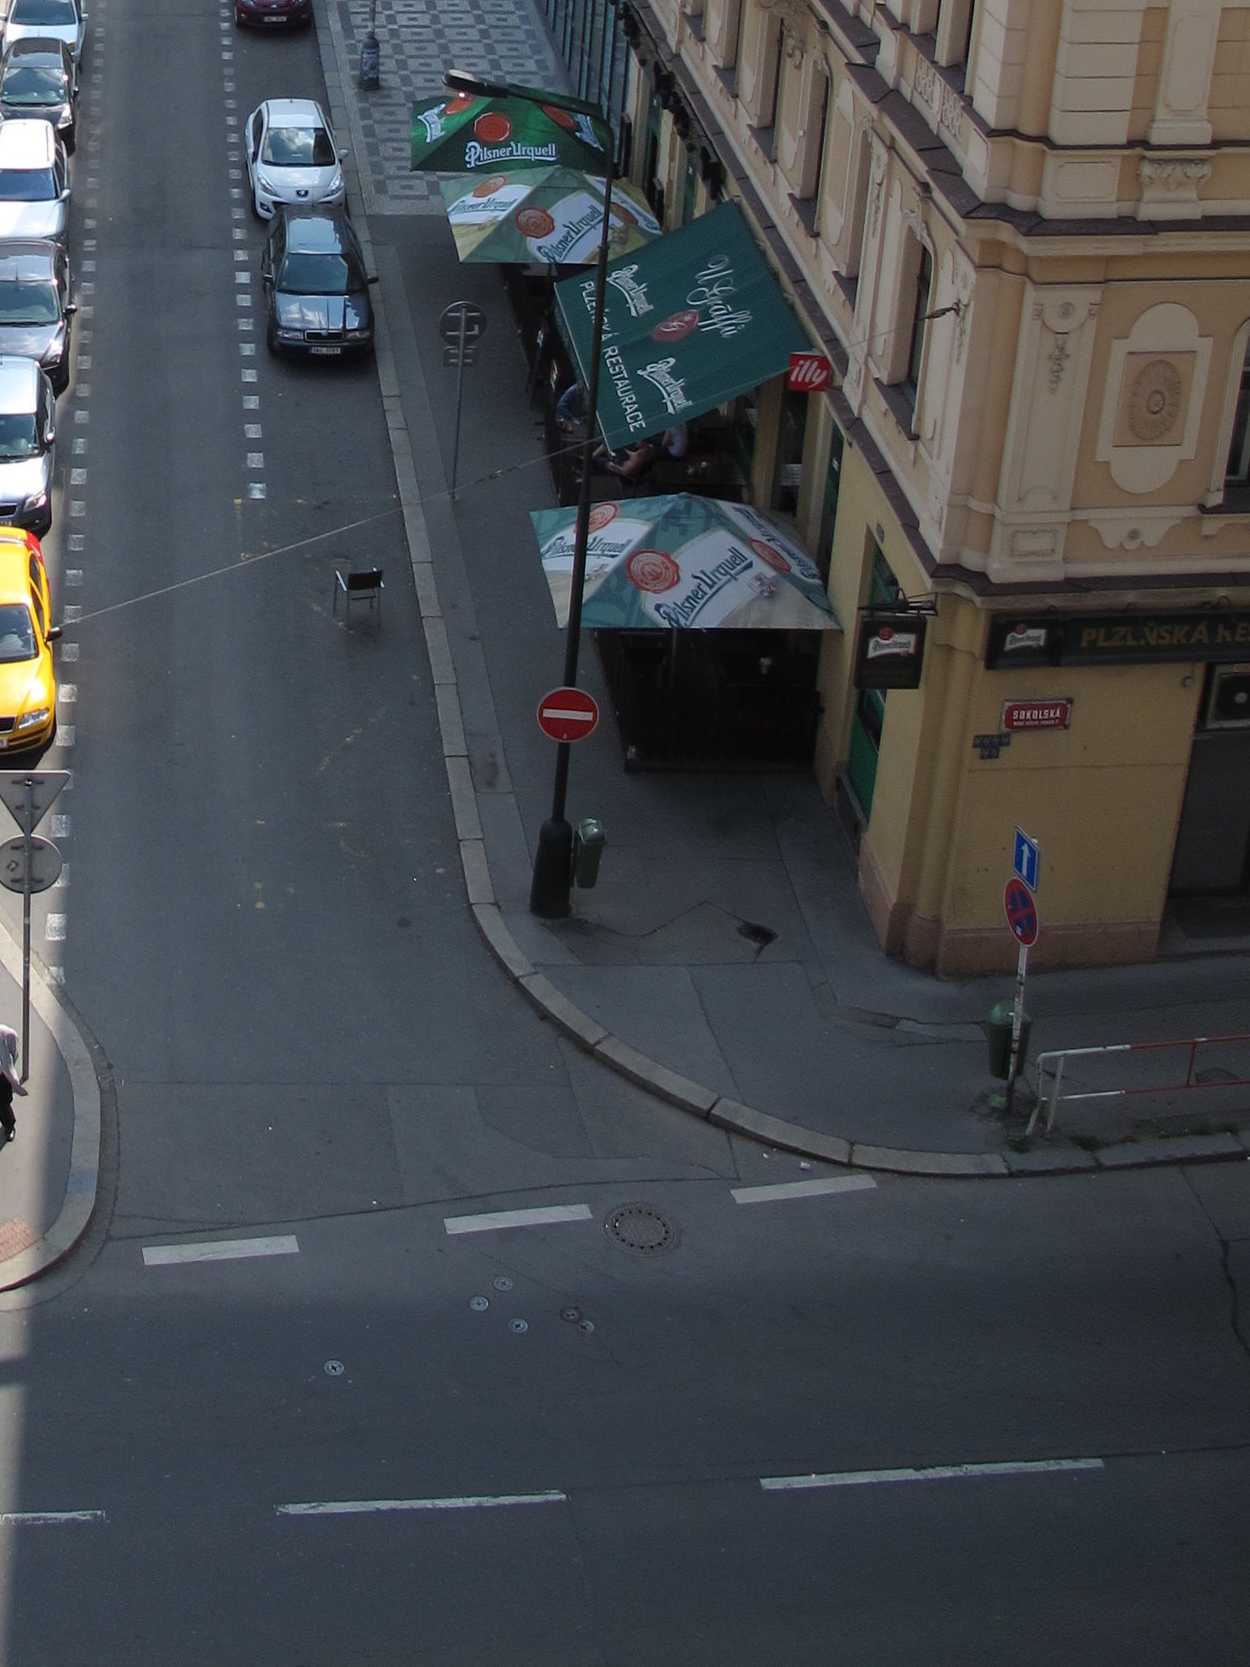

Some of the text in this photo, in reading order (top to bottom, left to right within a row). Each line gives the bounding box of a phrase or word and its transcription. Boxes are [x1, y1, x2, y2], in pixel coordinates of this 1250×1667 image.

[464, 141, 558, 168] Pilsner Urquell
[562, 205, 603, 240] Urquell
[603, 345, 646, 432] RESTAURACE
[791, 359, 828, 389] illy
[654, 547, 748, 628] Pilsner Urquell
[1013, 707, 1060, 719] SOKOLSKÁ
